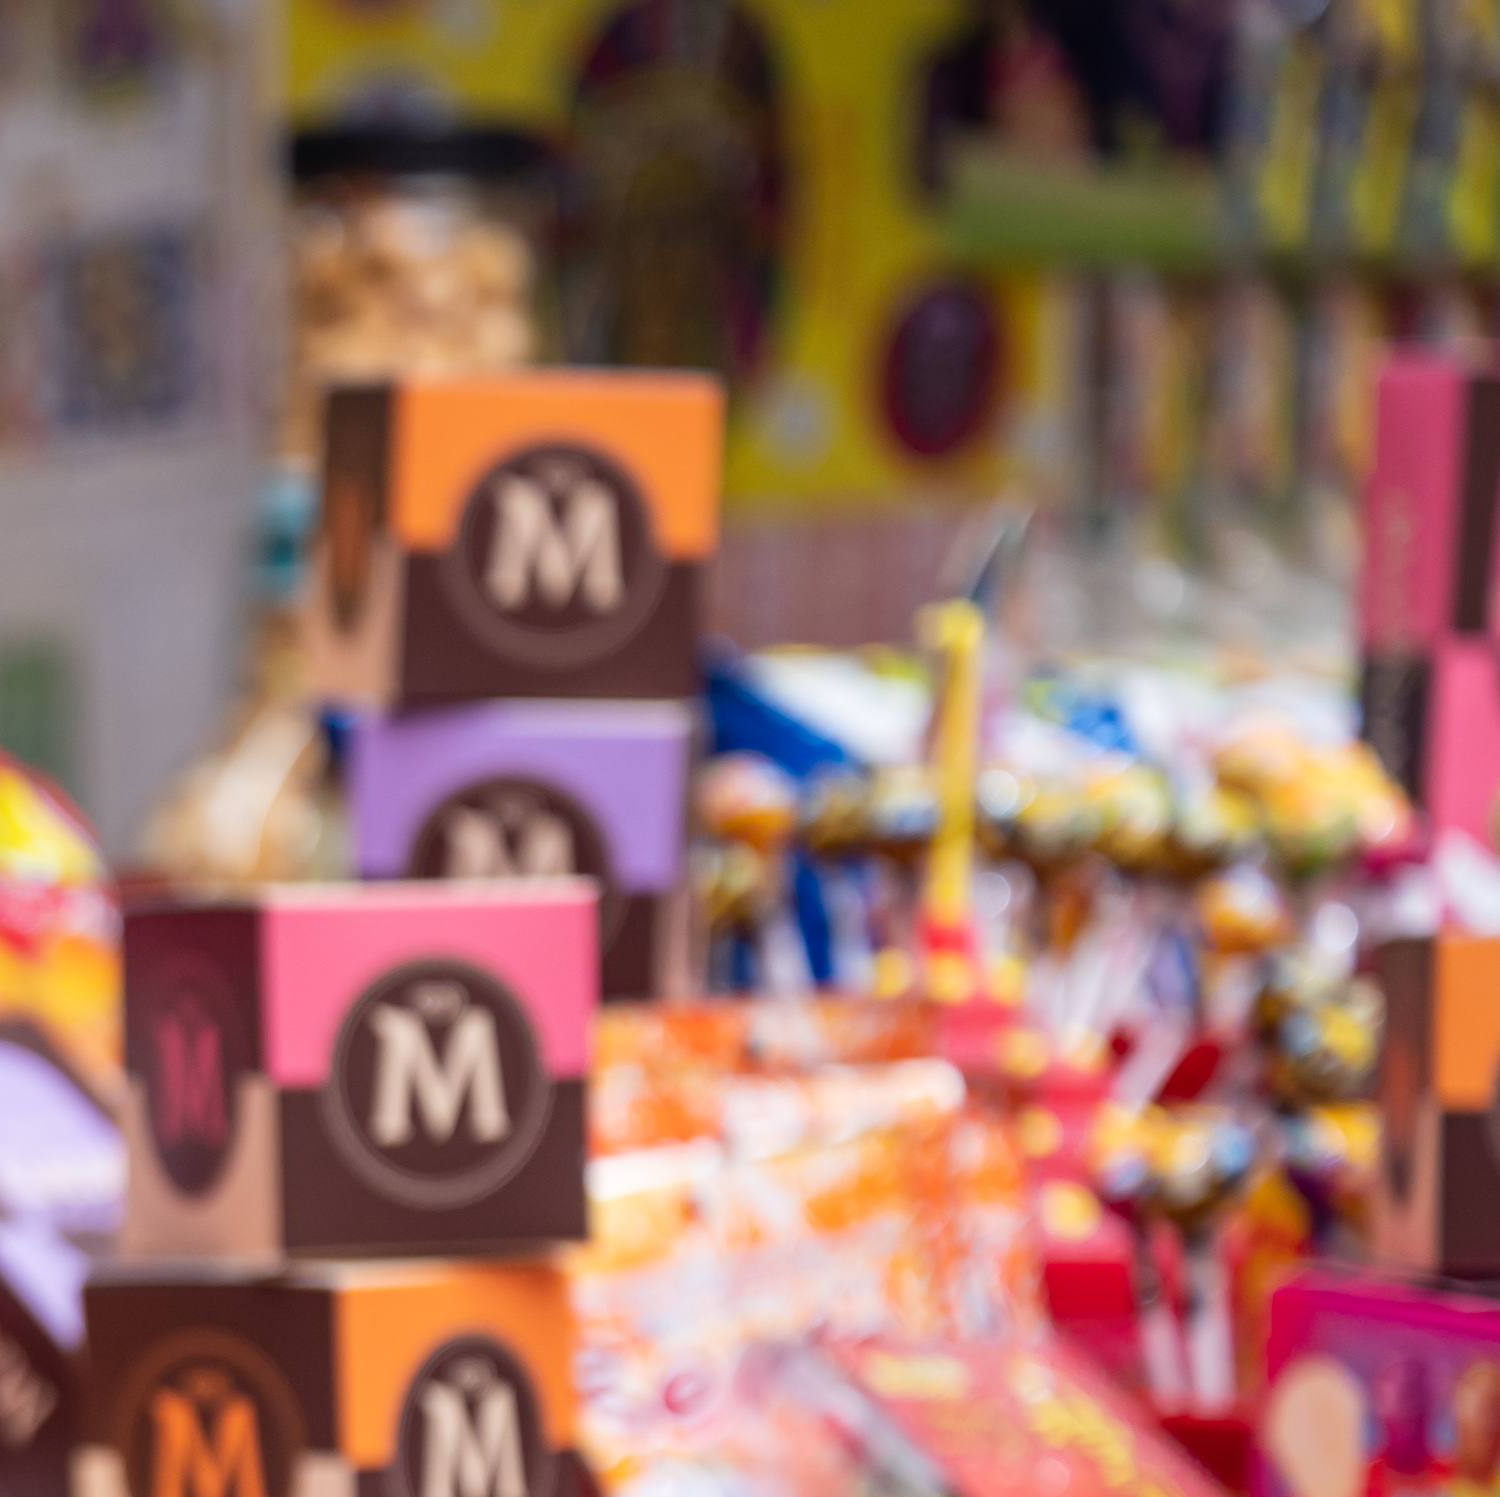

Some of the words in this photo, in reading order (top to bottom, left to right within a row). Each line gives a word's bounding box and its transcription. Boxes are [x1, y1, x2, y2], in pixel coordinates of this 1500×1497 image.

[486, 472, 625, 614] M
[155, 1009, 226, 1149] M
[370, 1002, 509, 1149] M
